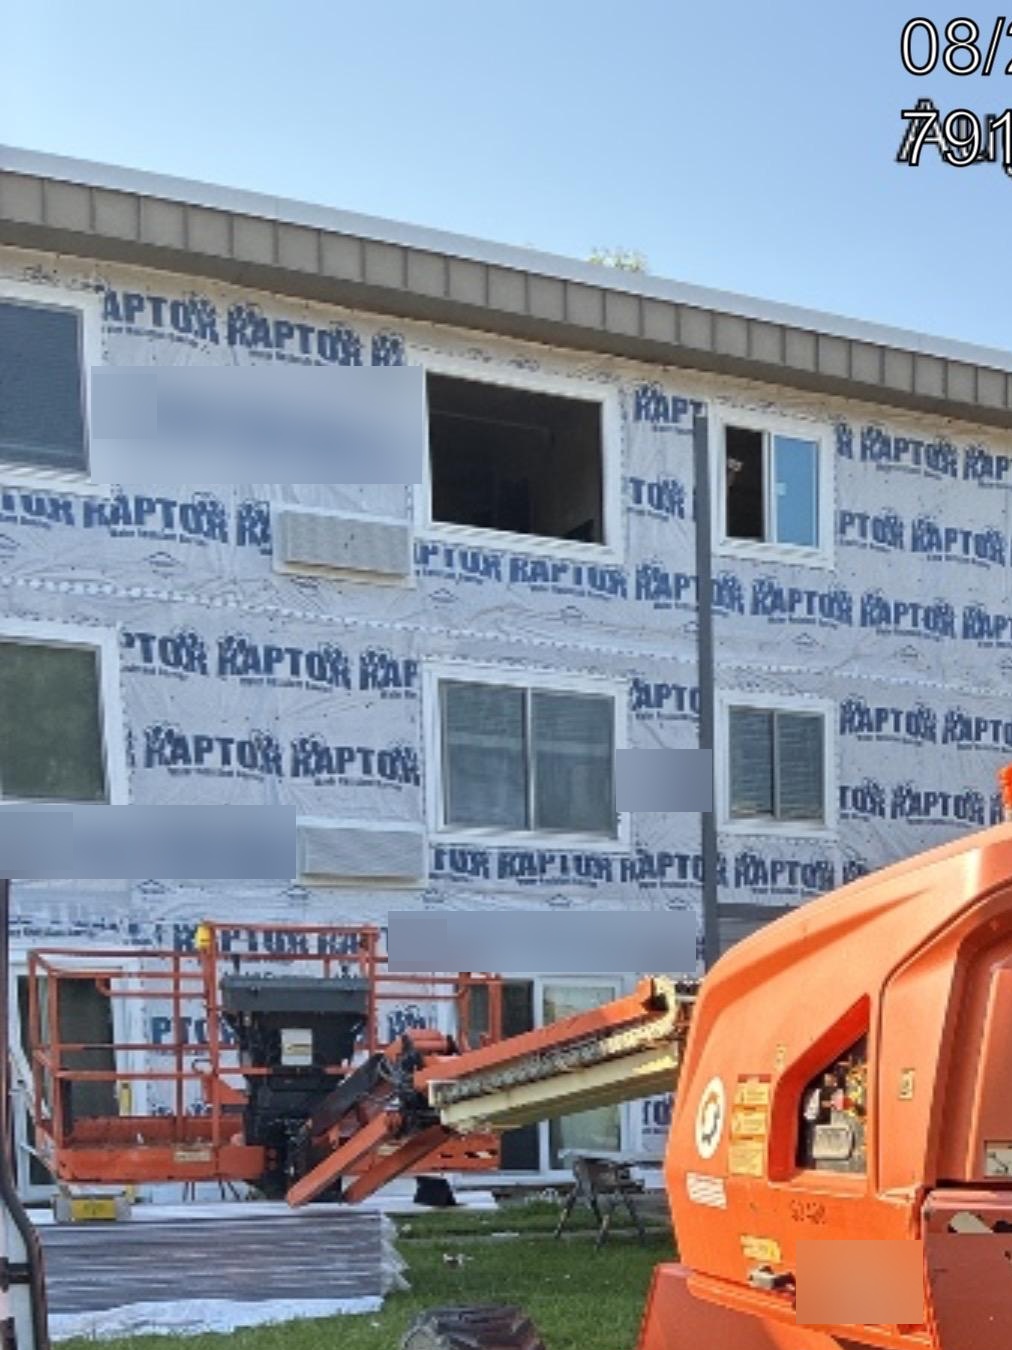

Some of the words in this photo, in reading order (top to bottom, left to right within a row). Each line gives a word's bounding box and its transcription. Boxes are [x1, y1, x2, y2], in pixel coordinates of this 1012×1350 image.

[227, 304, 363, 367] RAPTOR
[860, 425, 958, 479] RAPTOR
[82, 493, 230, 545] RAPTOR
[911, 517, 1006, 568] RAPTOR
[509, 556, 628, 600] RAPTOR
[751, 577, 853, 627] RAPTOR
[860, 591, 956, 640] RAPTOR
[217, 635, 352, 690] RAPTOR
[839, 699, 938, 745] RAPTOR
[144, 726, 284, 778] RAPTOR
[290, 735, 421, 785] RAPTOR
[890, 783, 985, 825] RAPTOR
[497, 850, 613, 882] RAPTOR
[734, 851, 835, 891] RAPTOR
